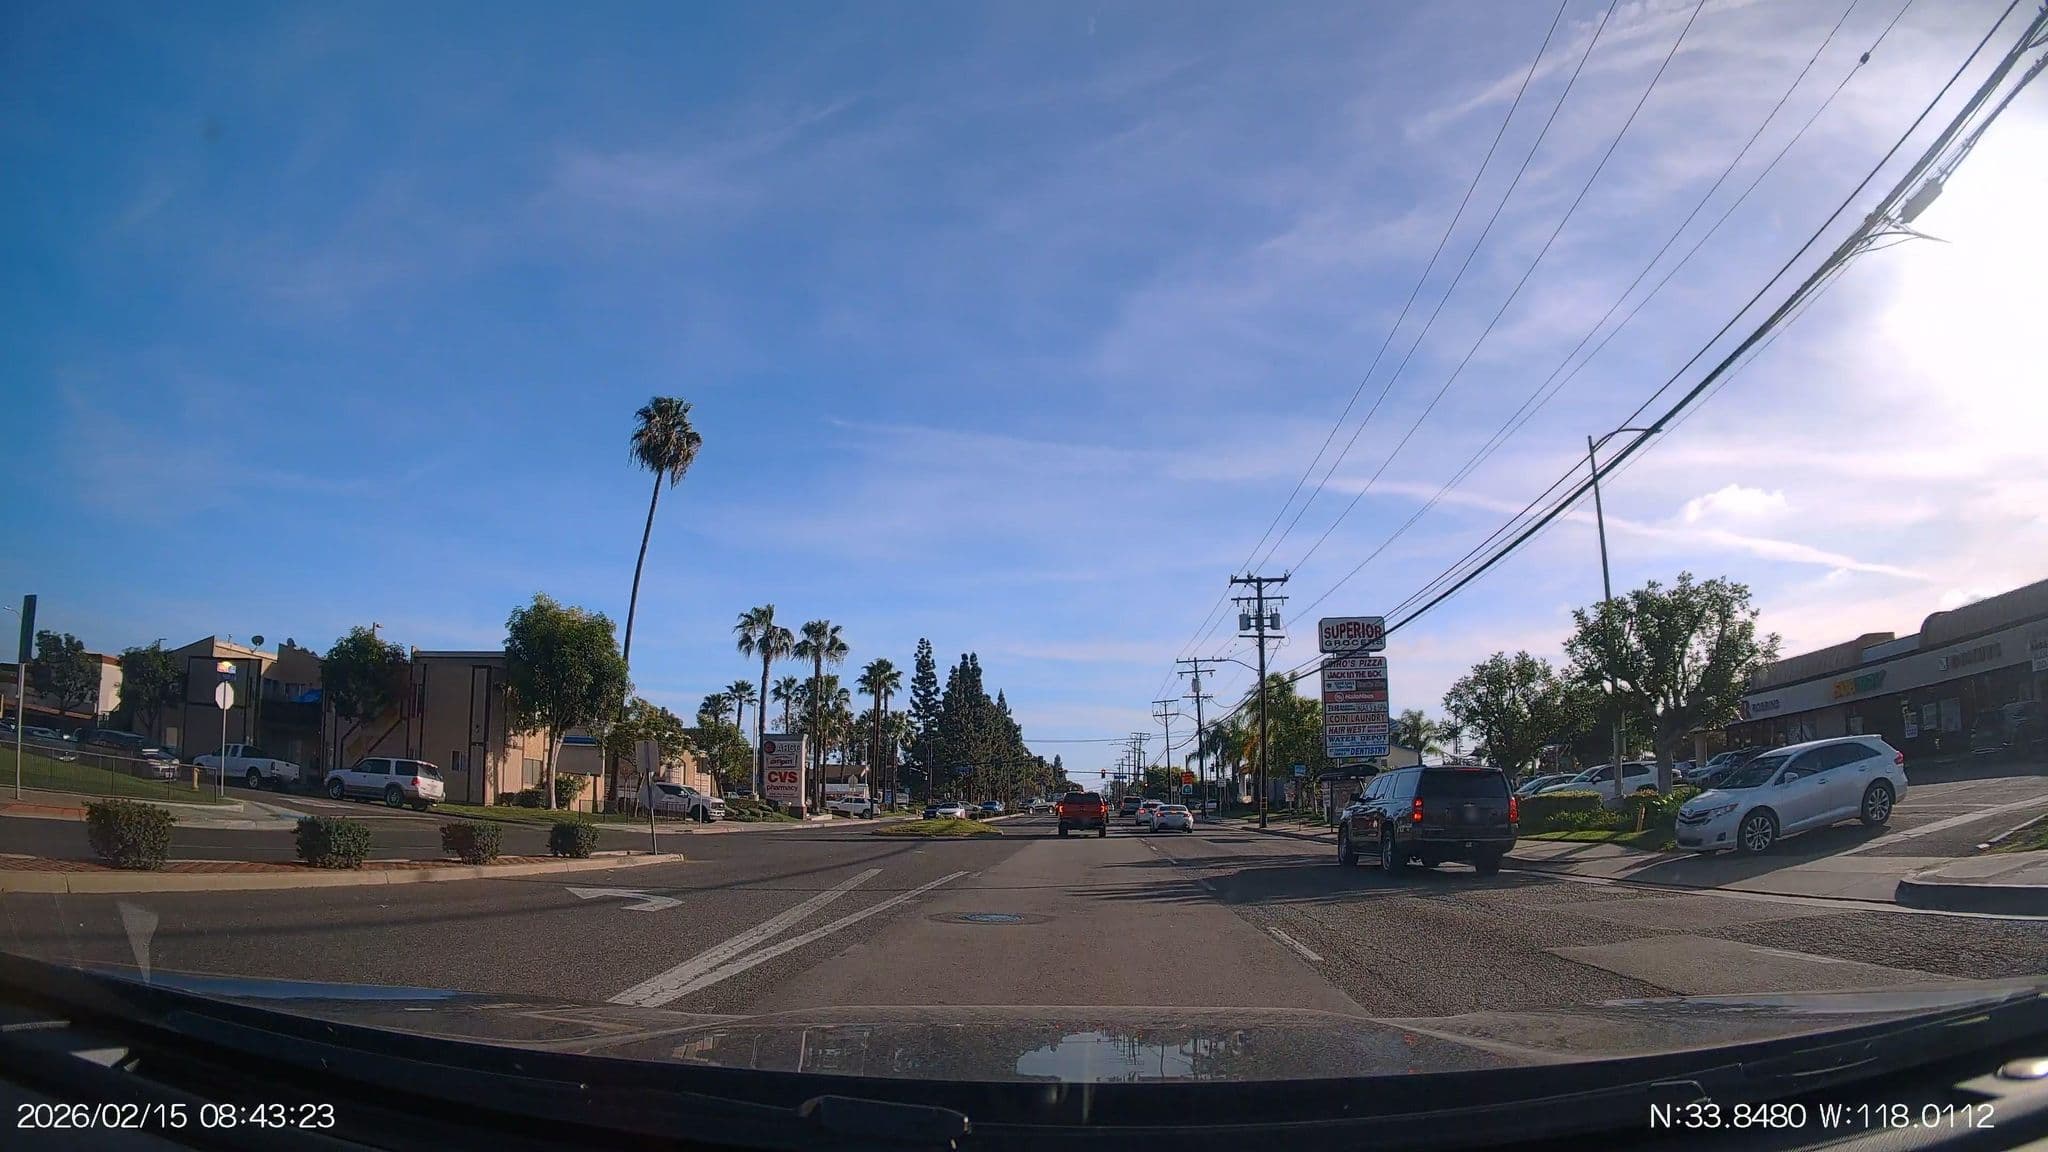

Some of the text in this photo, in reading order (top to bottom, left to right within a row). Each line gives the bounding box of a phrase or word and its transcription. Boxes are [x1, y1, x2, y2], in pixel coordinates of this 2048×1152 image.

[1323, 621, 1382, 639] SUPERIOR
[1359, 659, 1383, 667] PIZZA
[1327, 671, 1345, 679] JACK
[1355, 671, 1367, 679] THE
[1367, 670, 1382, 678] BOX
[1329, 713, 1386, 723] COIN LAUNDRY
[1328, 726, 1346, 734] HAIR
[1346, 725, 1367, 734] WEST
[1350, 746, 1387, 755] DENTISTRY
[767, 771, 798, 783] CVS
